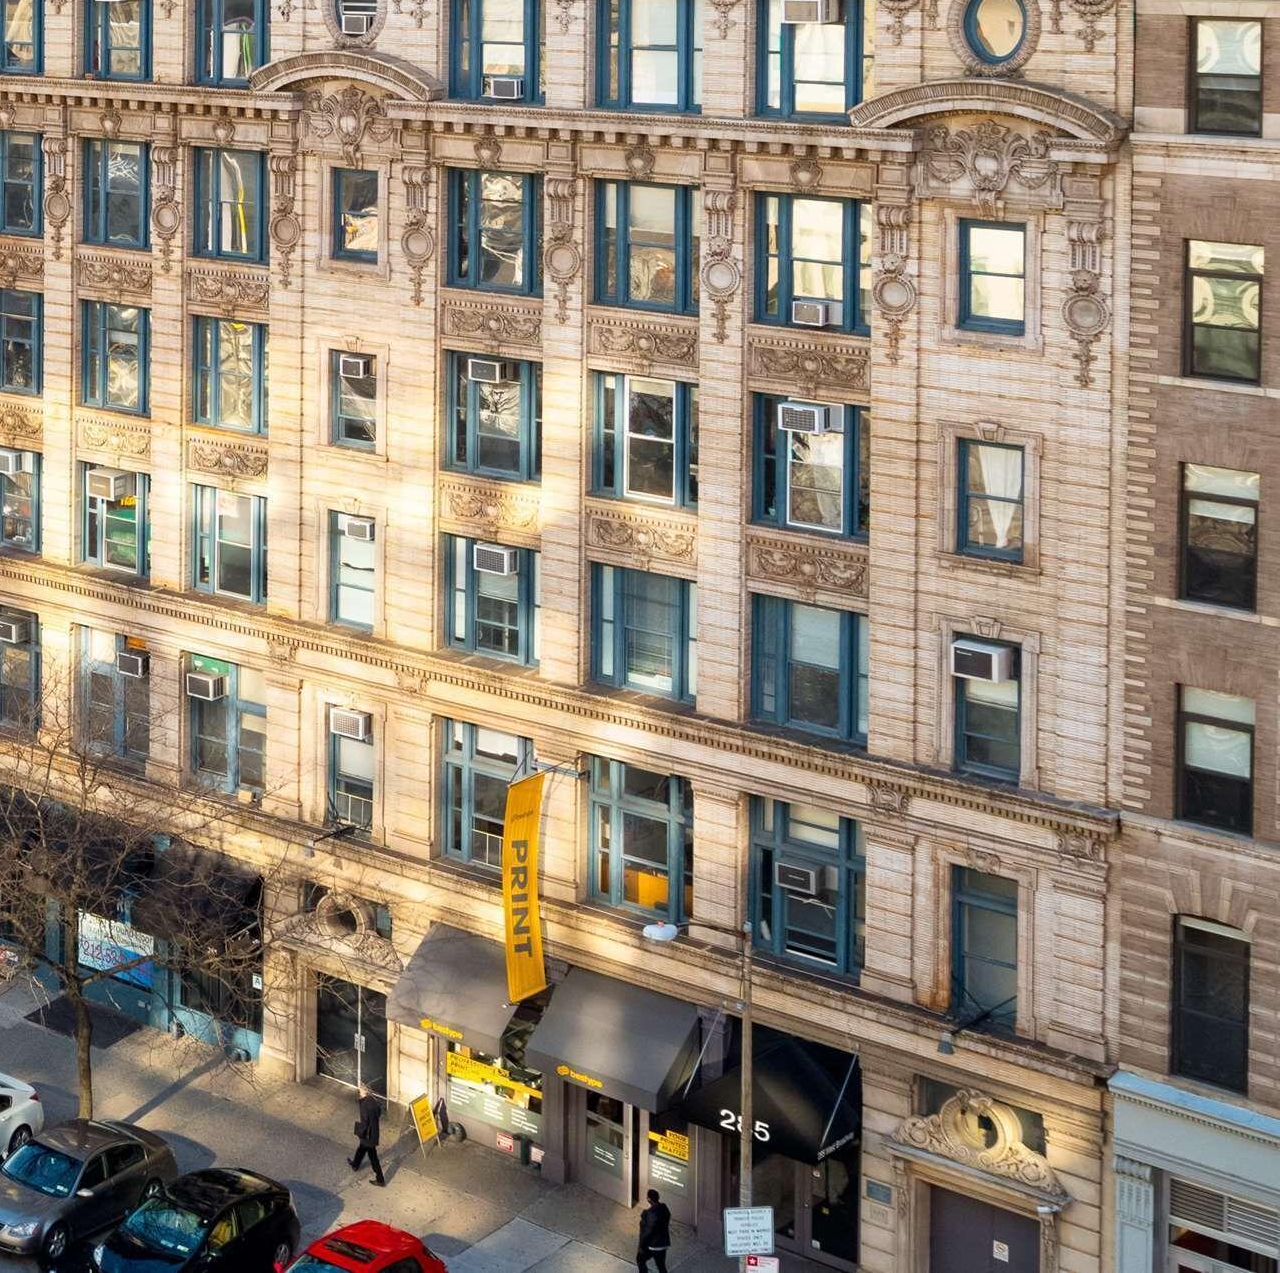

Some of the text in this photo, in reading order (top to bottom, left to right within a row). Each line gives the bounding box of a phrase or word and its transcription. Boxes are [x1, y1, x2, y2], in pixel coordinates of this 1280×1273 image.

[511, 839, 532, 958] PRINT
[570, 1070, 602, 1088] bestype
[661, 1136, 688, 1150] PRINTED
[669, 1131, 687, 1142] YOUR
